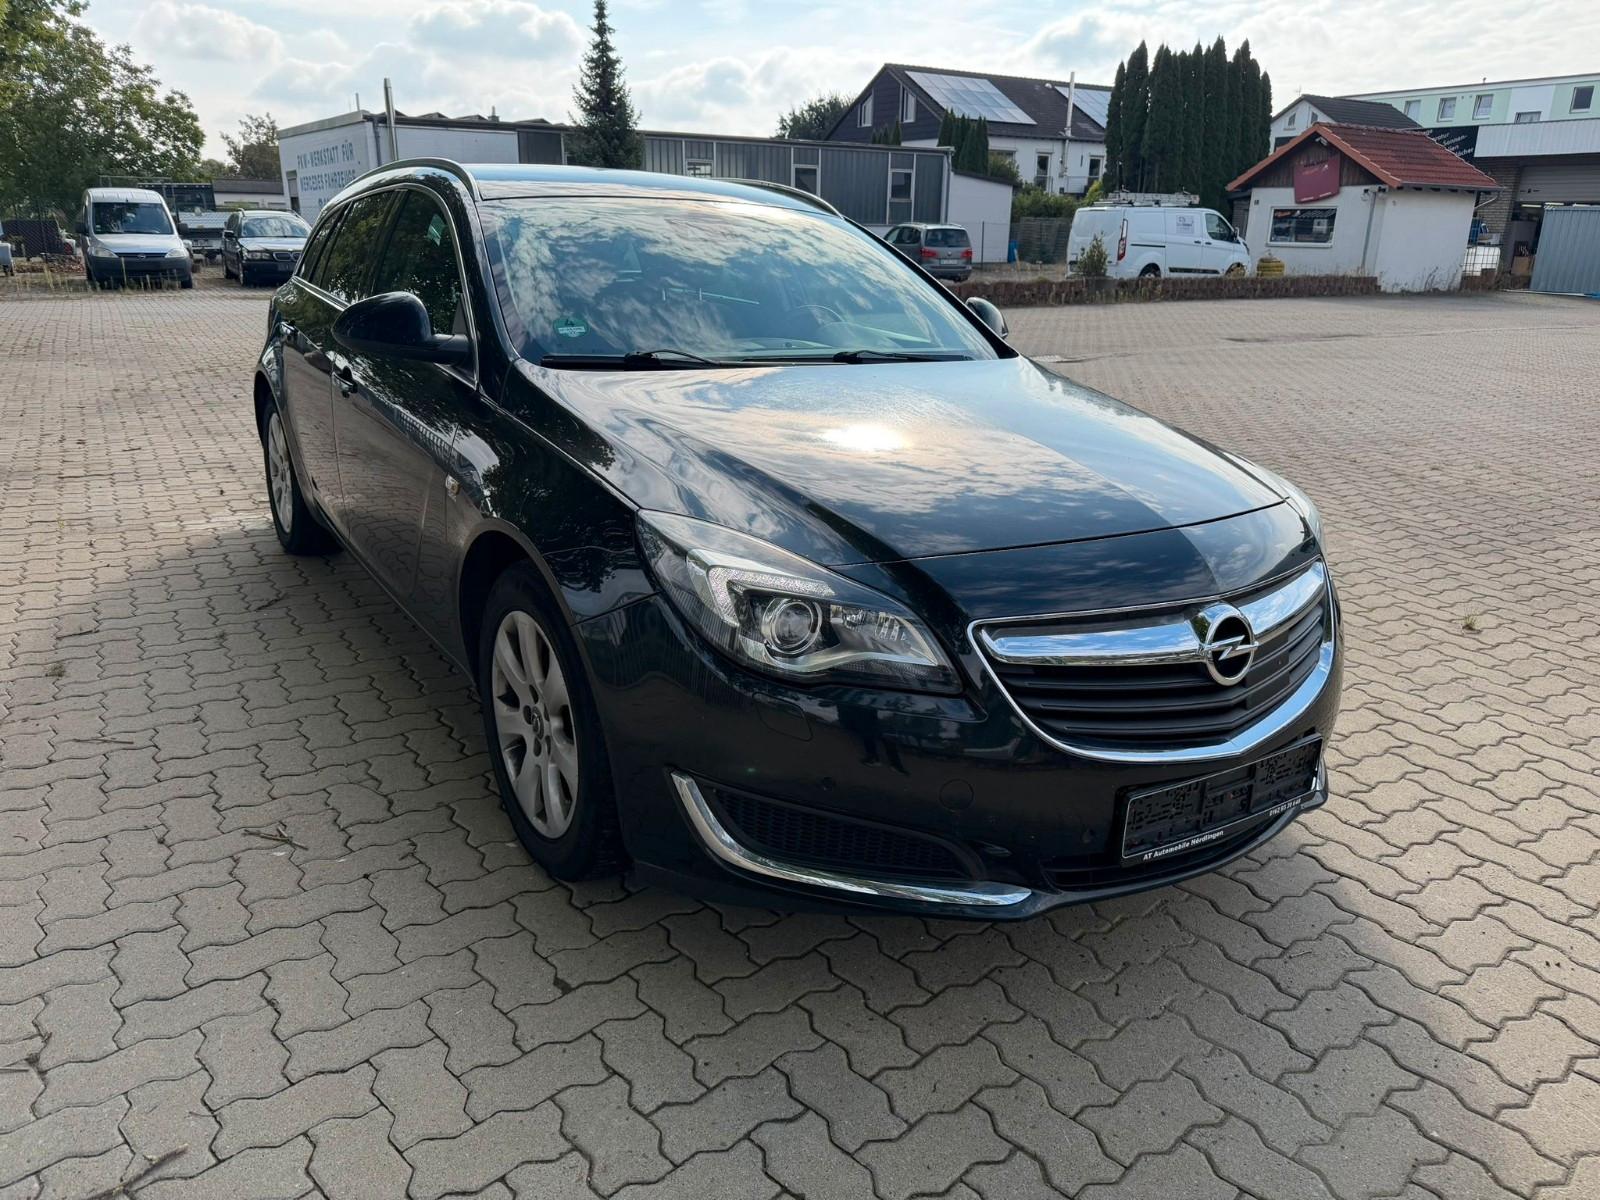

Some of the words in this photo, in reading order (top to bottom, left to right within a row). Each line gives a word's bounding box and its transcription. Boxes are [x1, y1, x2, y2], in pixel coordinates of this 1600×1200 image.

[297, 145, 339, 168] PKW-WERKSTATT
[341, 139, 354, 162] FÜR
[564, 319, 575, 327] 4
[1143, 853, 1153, 861] AT
[1153, 842, 1190, 858] Automobile
